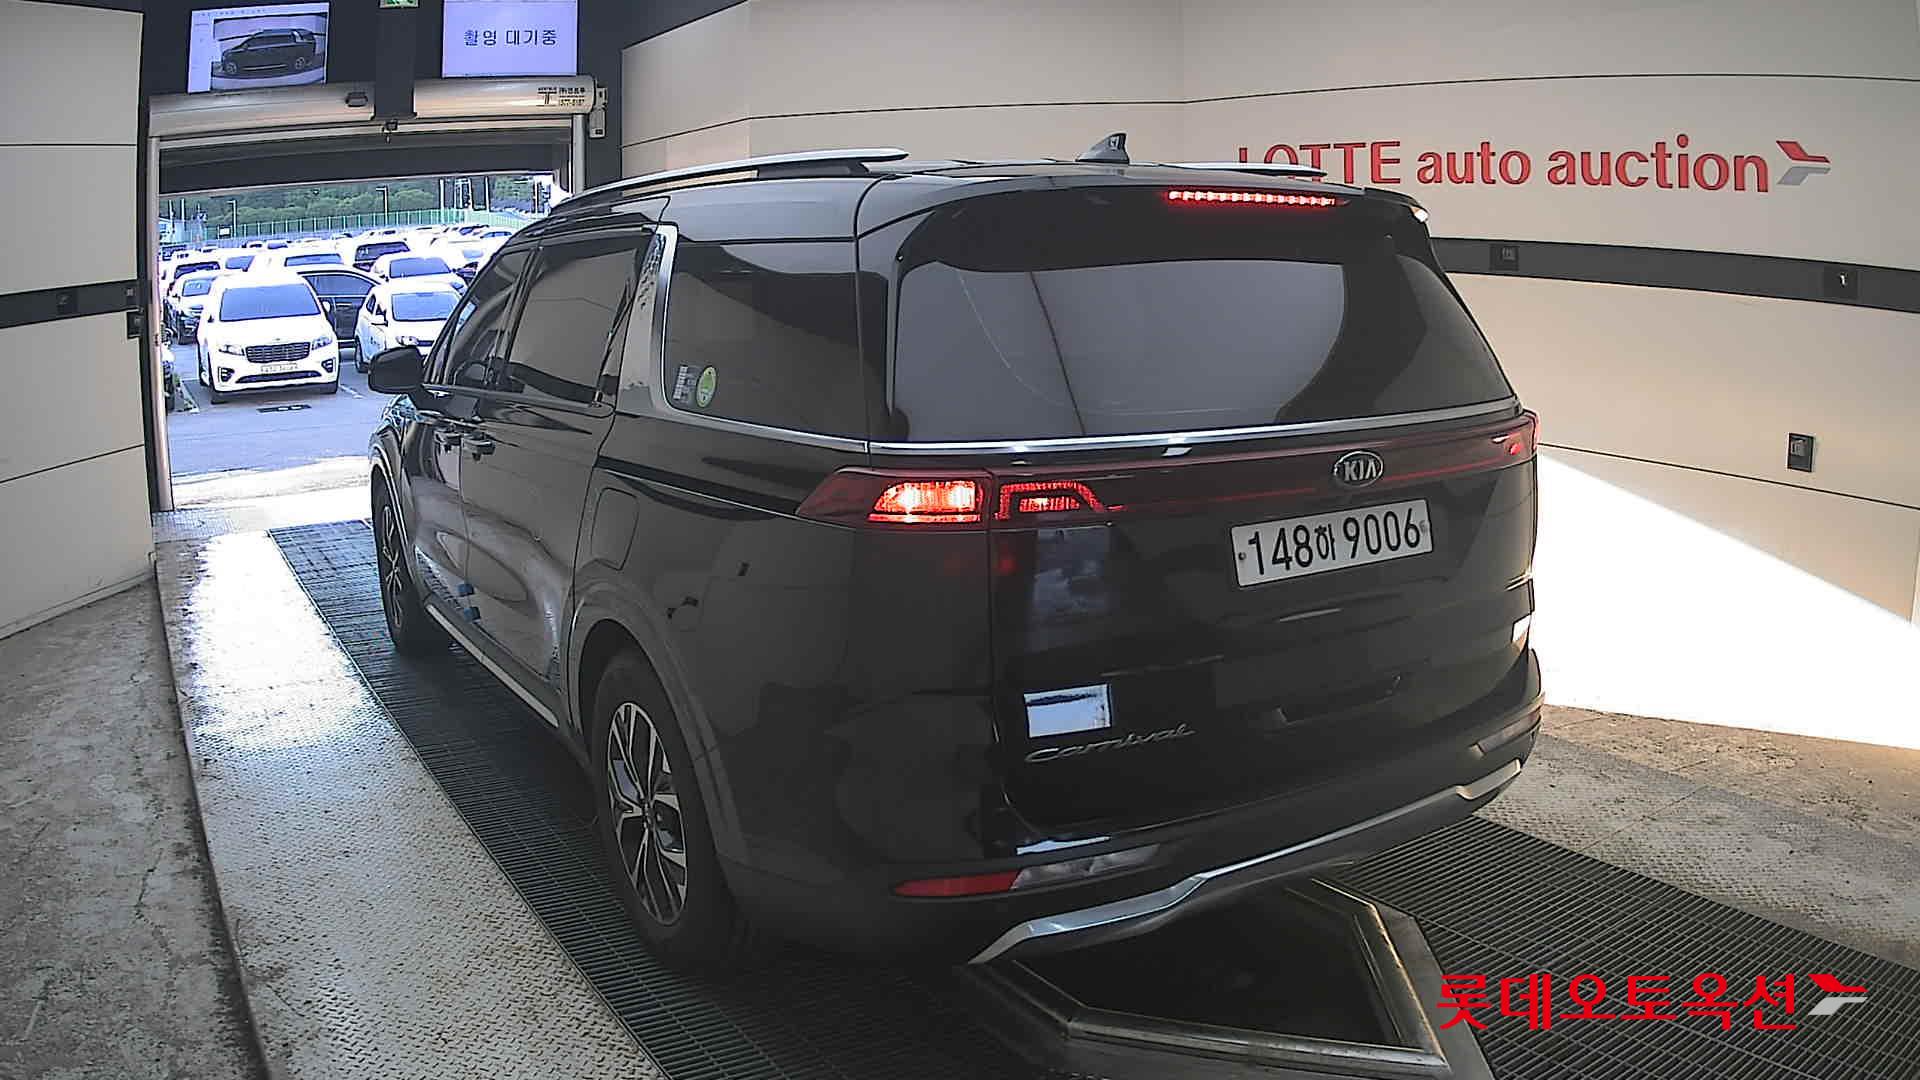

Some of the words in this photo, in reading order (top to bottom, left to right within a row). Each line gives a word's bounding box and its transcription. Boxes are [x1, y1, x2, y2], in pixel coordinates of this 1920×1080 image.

[505, 29, 557, 46] 대기중
[1416, 141, 1531, 185] auto
[1547, 134, 1769, 193] auction
[1343, 457, 1378, 482] KIA
[1248, 523, 1336, 575] 148하
[1342, 507, 1421, 559] 9006
